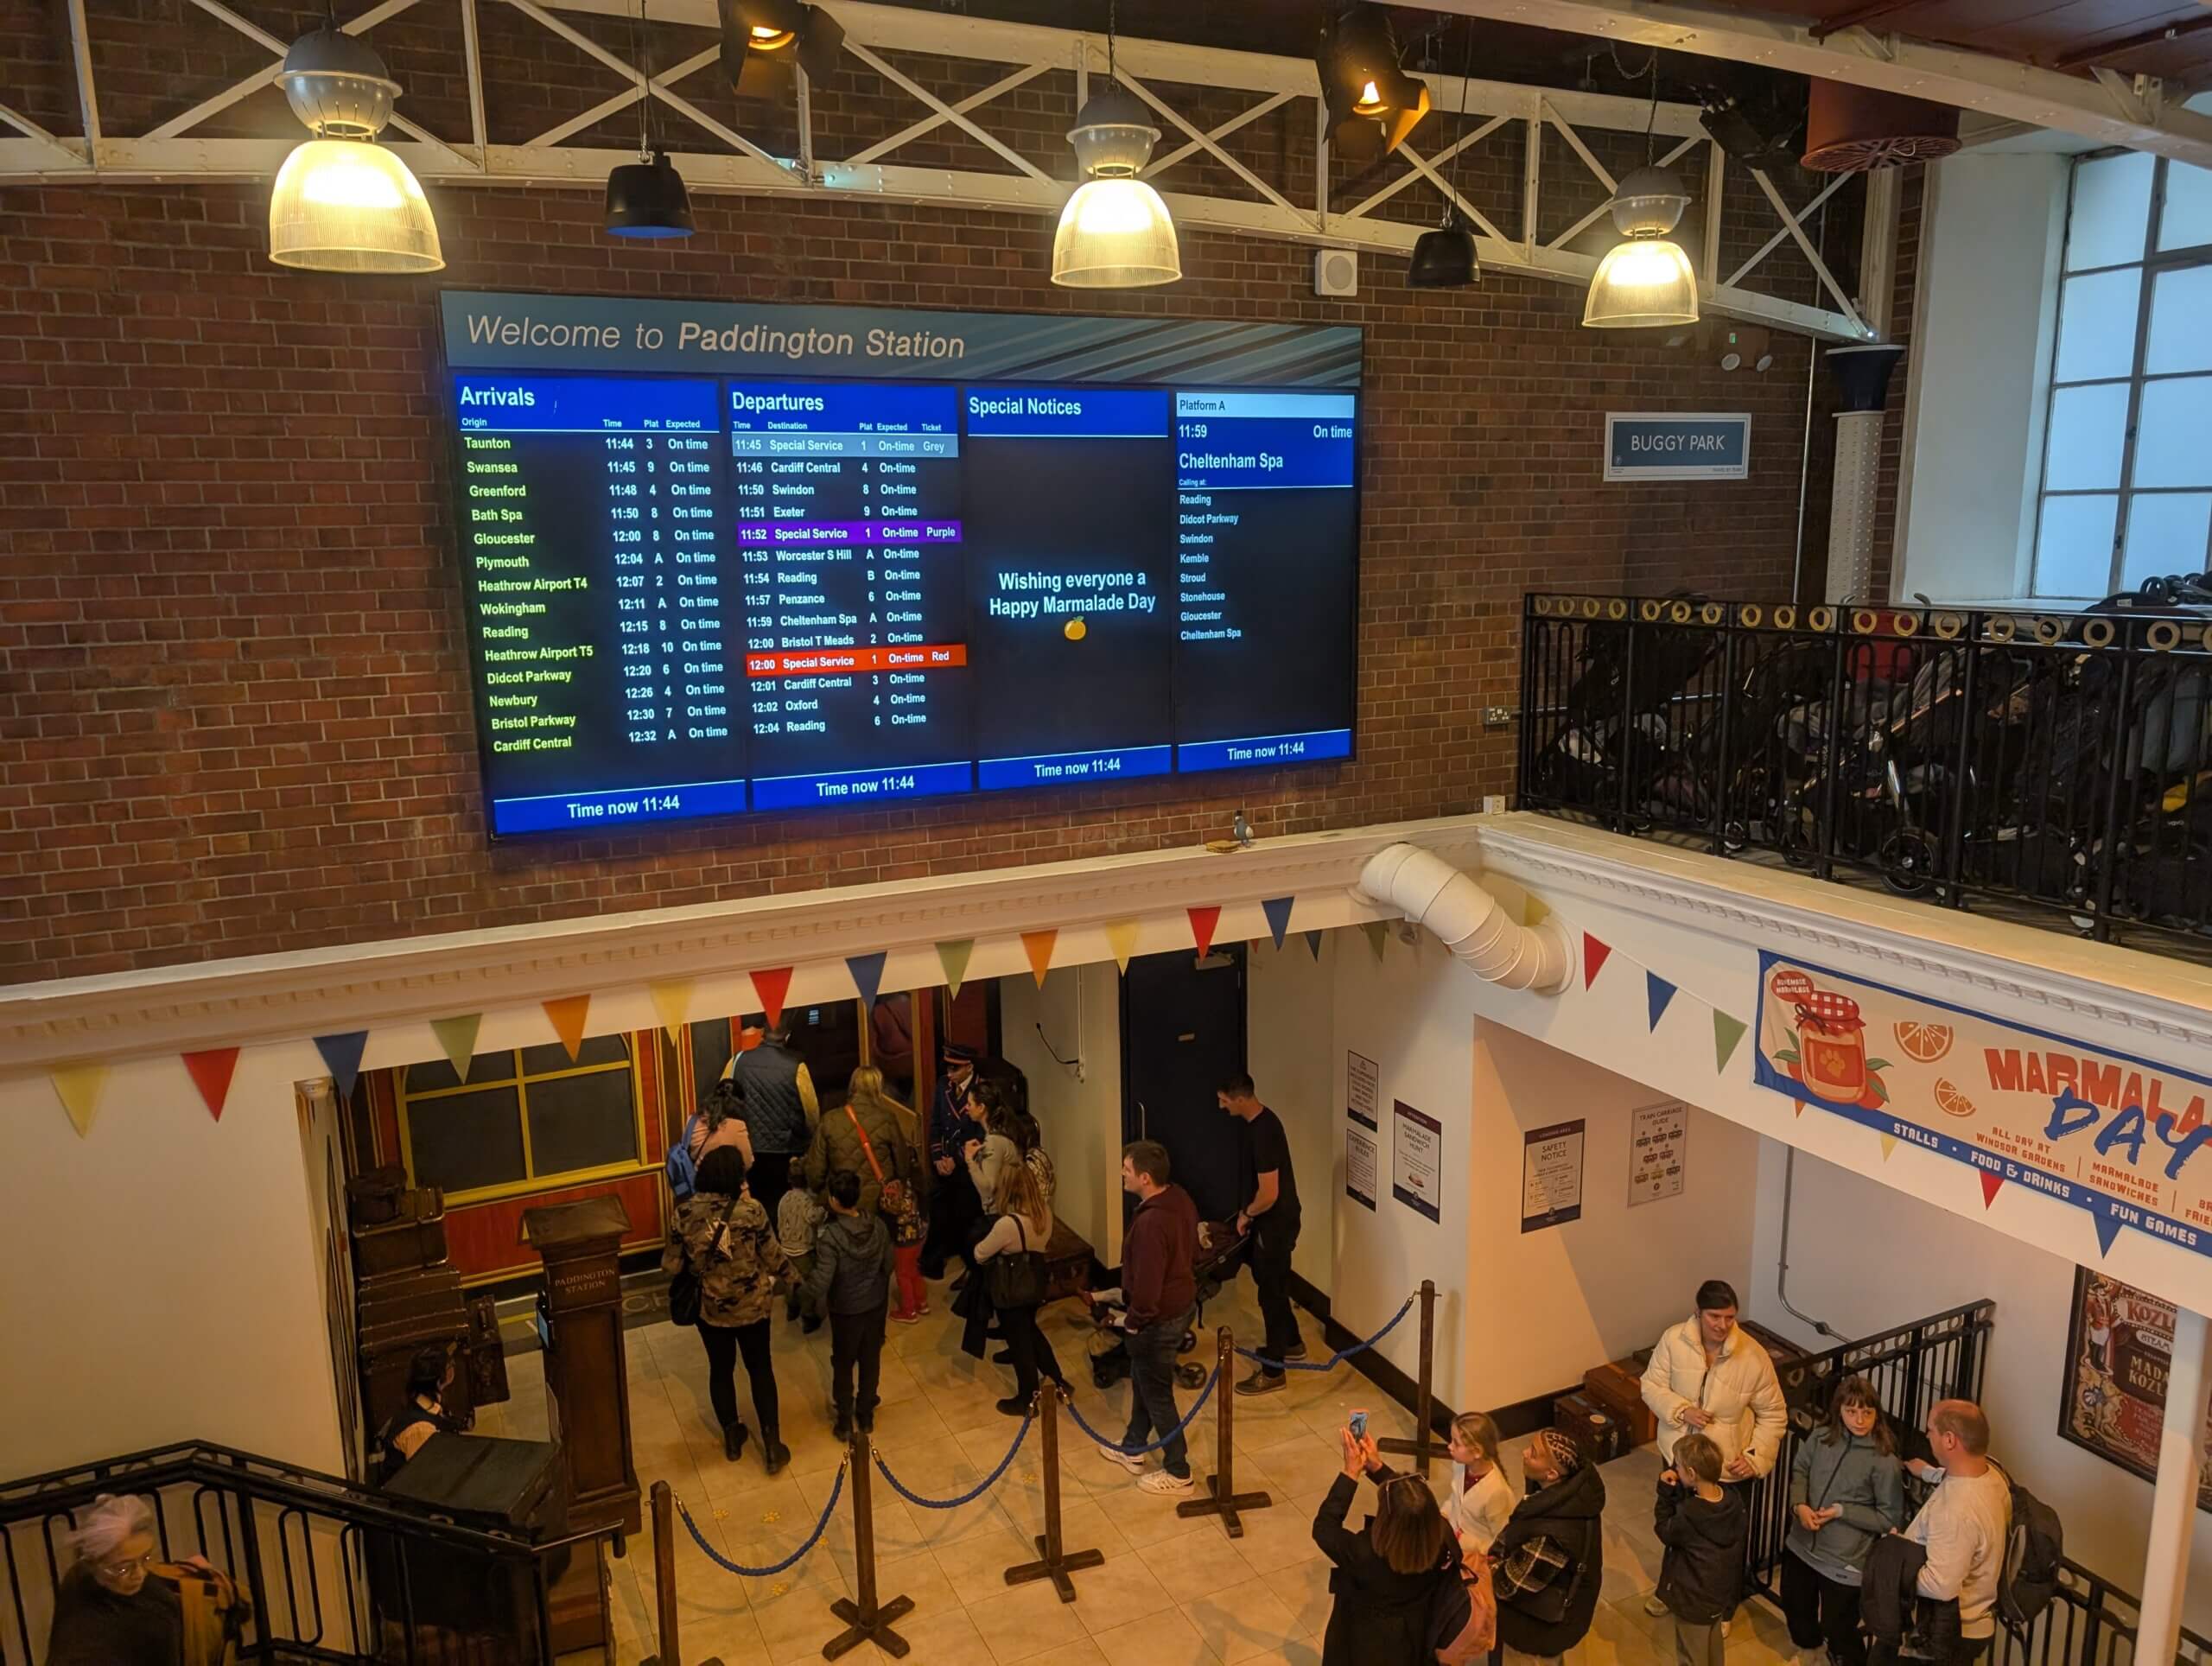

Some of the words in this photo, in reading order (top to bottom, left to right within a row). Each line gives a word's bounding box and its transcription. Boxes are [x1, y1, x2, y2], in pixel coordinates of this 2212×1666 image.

[468, 315, 620, 347] Welcome
[636, 323, 663, 349] to
[679, 322, 853, 359] Paddington
[867, 329, 963, 358] Station
[461, 386, 535, 405] Arrivals
[733, 392, 823, 414] Departures
[969, 397, 1022, 417] Special
[1028, 398, 1081, 415] Notices
[1180, 400, 1216, 410] Platform
[1219, 401, 1225, 410] A
[462, 418, 486, 428] Origin
[666, 420, 700, 429] Expected
[877, 423, 907, 432] Expected
[1179, 424, 1207, 437] 11:59
[1313, 425, 1327, 437] On
[1331, 425, 1352, 437] time
[464, 437, 511, 448] Taunton
[606, 438, 633, 448] 11:44
[668, 439, 683, 449] On
[686, 438, 708, 449] time
[735, 440, 761, 449] 11:45
[770, 440, 805, 452] Special
[808, 440, 842, 450] Service
[879, 441, 914, 451] On-time
[924, 442, 944, 454] Grey
[1631, 435, 1685, 451] BUGGY
[1689, 435, 1726, 450] PARK
[467, 461, 518, 473] Swansea
[771, 462, 804, 473] Cardiff
[806, 462, 840, 473] Central
[1179, 453, 1255, 468] Cheltenham
[1260, 453, 1283, 471] Spa
[469, 485, 525, 496] Greenford
[772, 485, 814, 494] Swindon
[1180, 494, 1211, 506] Reading
[472, 509, 498, 520] Bath
[501, 509, 523, 523] Spa
[774, 506, 804, 517] Exeter
[1180, 514, 1205, 524] Didcot
[1206, 514, 1238, 525] Parkway
[474, 533, 535, 544] Gloucester
[741, 529, 766, 539] 11:52
[775, 529, 810, 541] Special
[812, 528, 848, 538] Service
[883, 527, 918, 537] On-time
[927, 527, 955, 538] Purple
[1180, 534, 1213, 544] Swindon
[776, 550, 825, 561] Worcester
[827, 550, 834, 560] S
[836, 550, 851, 560] Hill
[1180, 553, 1209, 563] Kemble
[476, 556, 529, 570] Plymouth
[778, 572, 817, 584] Reading
[999, 572, 1061, 592] Wishing
[1066, 573, 1133, 590] everyone
[1137, 573, 1146, 585] a
[1180, 573, 1205, 582] Stroud
[479, 580, 531, 591] Heathrow
[533, 579, 572, 592] Airport
[574, 577, 588, 588] T4
[779, 595, 824, 604] Penzance
[1181, 592, 1225, 601] Stonehouse
[480, 602, 545, 616] Wokingham
[990, 598, 1039, 618] Happy
[1044, 594, 1124, 613] Marmalade
[1128, 593, 1155, 613] Day
[780, 615, 836, 626] Cheltenham
[839, 614, 857, 626] Spa
[1181, 611, 1222, 621] Gloucester
[483, 626, 528, 639] Reading
[1181, 630, 1225, 639] Cheltenham
[1227, 628, 1241, 639] Spa
[782, 636, 813, 647] Bristol
[816, 636, 822, 645] T
[824, 635, 854, 645] Meads
[485, 650, 537, 661] Heathrow
[540, 647, 577, 660] Airport
[579, 645, 593, 656] T5
[750, 659, 775, 670] 12:00
[783, 658, 817, 671] Special
[820, 657, 854, 666] Service
[889, 653, 924, 663] On-time
[932, 652, 949, 660] Red
[487, 672, 524, 684] Didcot
[526, 671, 571, 683] Parkway
[785, 678, 816, 690] Cardiff
[818, 677, 851, 688] Central
[490, 695, 537, 707] Newbury
[785, 699, 817, 710] Oxford
[492, 716, 528, 729] Bristol
[530, 715, 575, 728] Parkway
[787, 721, 825, 732] Reading
[494, 739, 531, 752] Cardiff
[533, 736, 571, 749] Central
[1228, 748, 1252, 760] Time
[1255, 747, 1275, 757] now
[1279, 741, 1304, 755] 11:44
[1034, 765, 1062, 777] Time
[1065, 764, 1089, 774] now
[1092, 758, 1120, 772] 11:44
[817, 783, 848, 796] Time
[852, 782, 878, 793] now
[882, 776, 914, 790] 11:44
[567, 804, 603, 817] Time
[608, 802, 638, 814] now
[643, 795, 679, 811] 11:44
[1984, 1048, 2212, 1148] MARMALA
[1656, 1107, 1683, 1118] CARRIAGE
[1652, 1117, 1669, 1126] GUIDE
[1402, 1122, 1432, 1144] MARMALADE
[1893, 1122, 1939, 1148] STALLS
[2044, 1085, 2212, 1180] DAY
[1404, 1132, 1430, 1149] SANDWICH
[1992, 1127, 2011, 1141] ALL
[2015, 1135, 2033, 1147] DAY
[2037, 1142, 2051, 1154] AT
[1409, 1142, 1424, 1154] HUNT
[1542, 1141, 1567, 1154] SAFETY
[1976, 1132, 2018, 1155] WINDSOR
[2022, 1149, 2066, 1173] GARDENS
[1541, 1149, 1567, 1161] NOTICE
[1970, 1150, 2001, 1172] FOOD
[2006, 1163, 2018, 1178] &
[2023, 1170, 2070, 1198] DRINKS
[2092, 1161, 2159, 1192] MARMALADE
[2089, 1174, 2158, 1206] SANDWICHES
[2110, 1203, 2139, 1224] FUN
[2145, 1216, 2197, 1246] GAMES
[2185, 1209, 2212, 1227] FRIE
[555, 1268, 615, 1287] PADDINGTON
[565, 1280, 606, 1294] STATION
